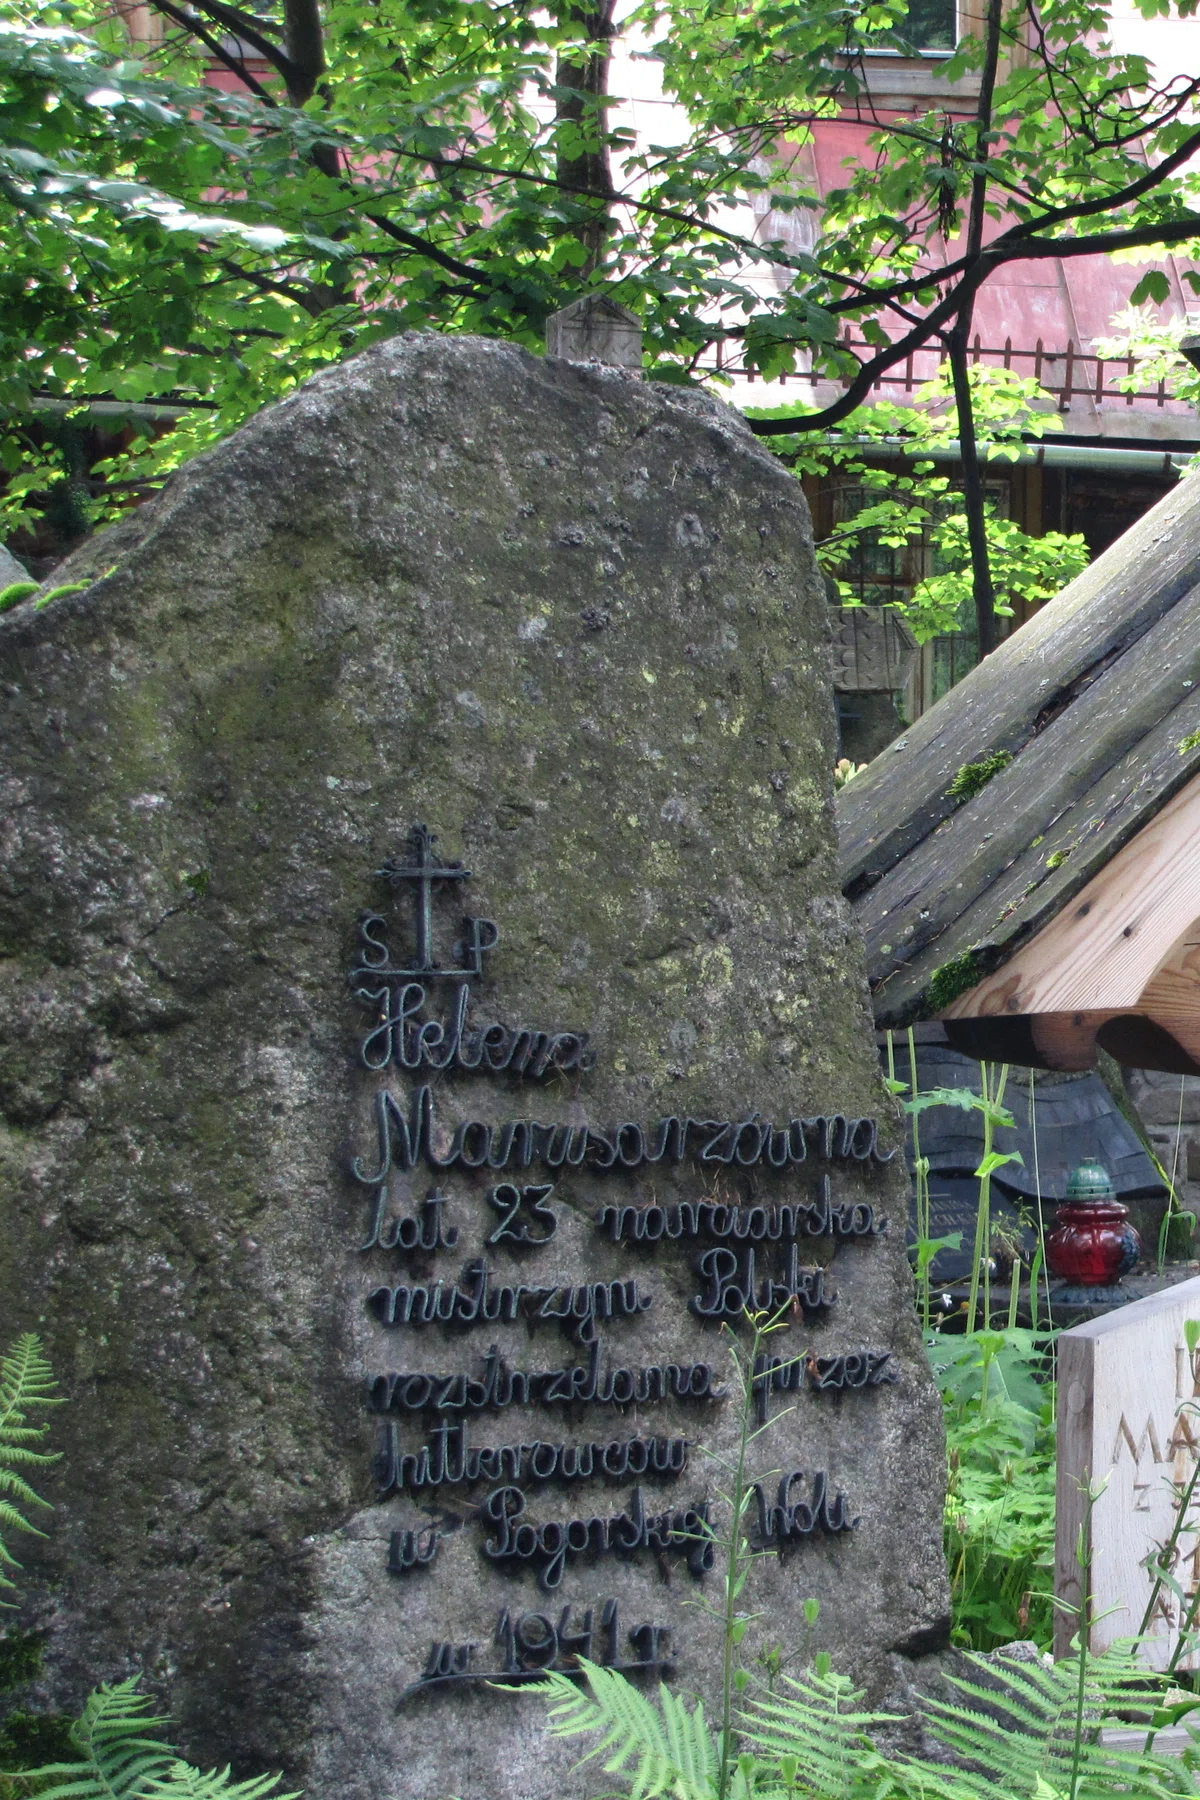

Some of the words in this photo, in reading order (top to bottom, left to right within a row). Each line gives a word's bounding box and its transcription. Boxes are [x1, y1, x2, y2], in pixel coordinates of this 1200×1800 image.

[356, 983, 597, 1076] Helena
[489, 1183, 558, 1245] 23
[693, 1242, 841, 1316] Polski
[1132, 1483, 1152, 1513] Z
